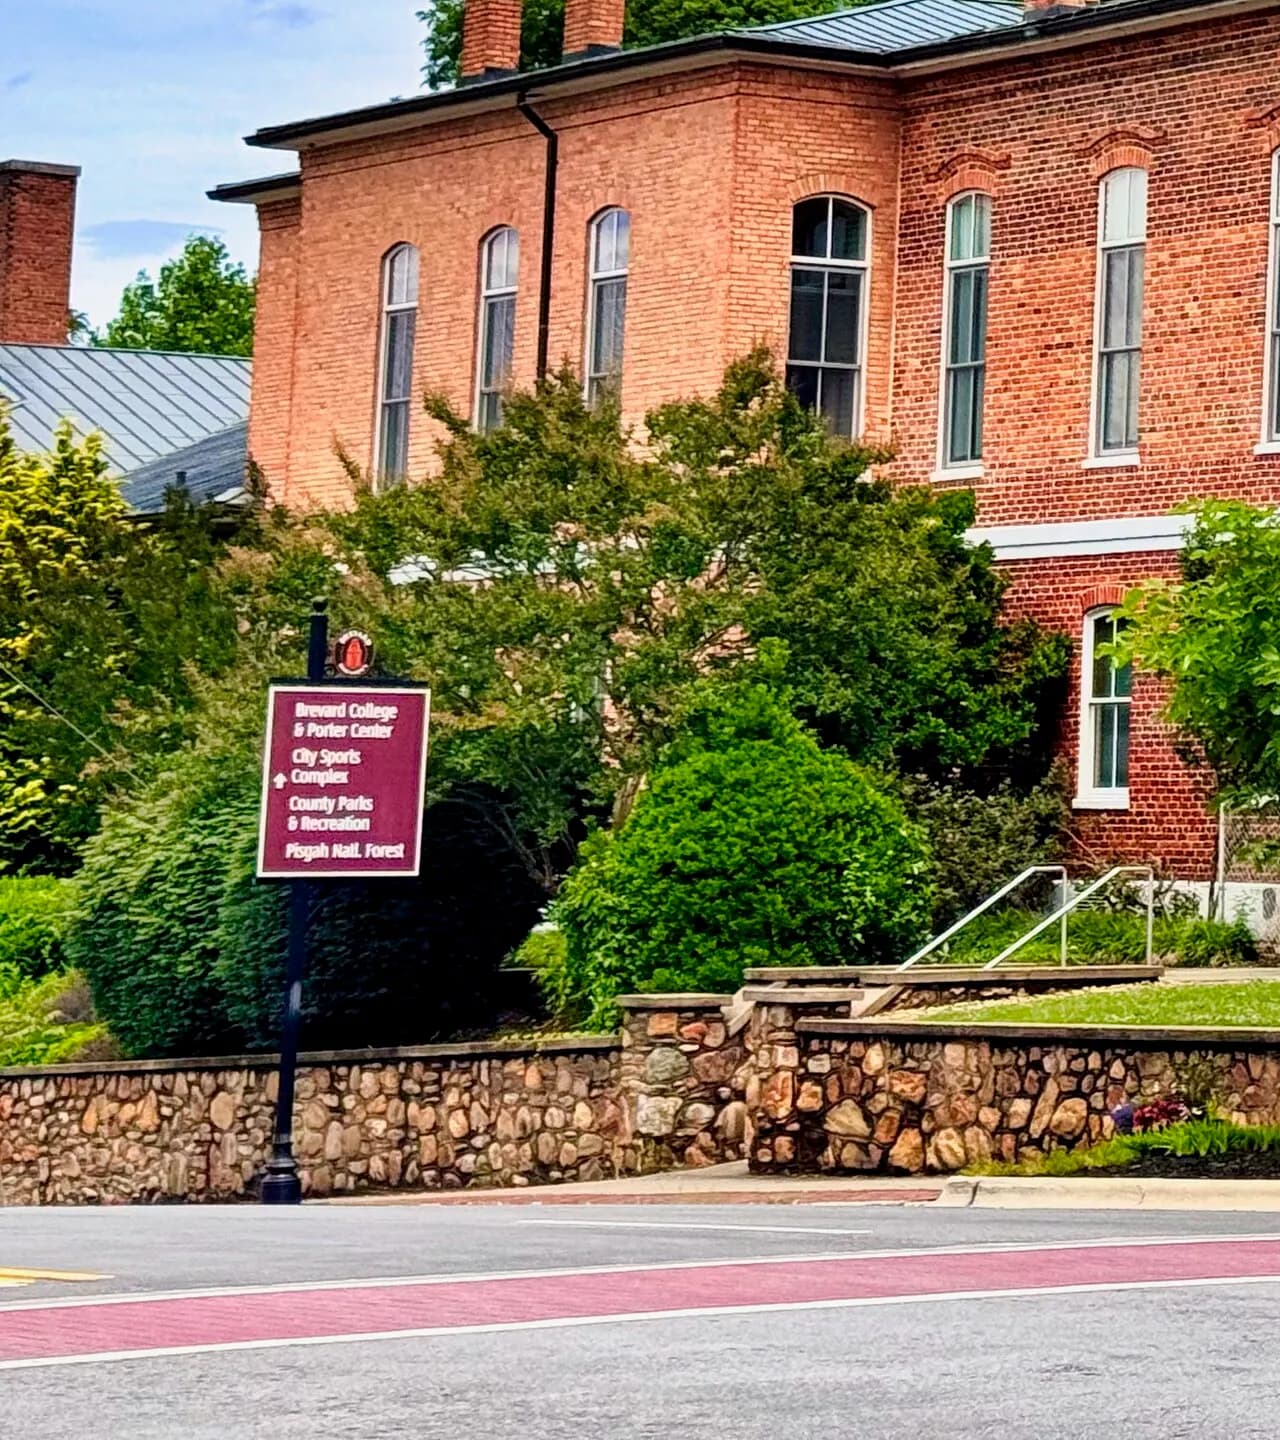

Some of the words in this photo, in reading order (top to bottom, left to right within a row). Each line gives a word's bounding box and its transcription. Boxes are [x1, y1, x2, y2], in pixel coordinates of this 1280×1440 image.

[295, 701, 347, 718] Brevard
[349, 702, 398, 722] College
[294, 722, 305, 737] &
[307, 722, 349, 737] Porter
[350, 722, 394, 738] Center
[292, 747, 318, 767] City
[319, 748, 362, 767] Sports
[291, 767, 350, 788] Complex
[289, 795, 335, 815] County
[336, 794, 374, 811] Parks
[288, 815, 298, 831] &
[300, 815, 371, 831] Recreation
[285, 841, 330, 862] Pisgah
[364, 842, 405, 858] Forest
